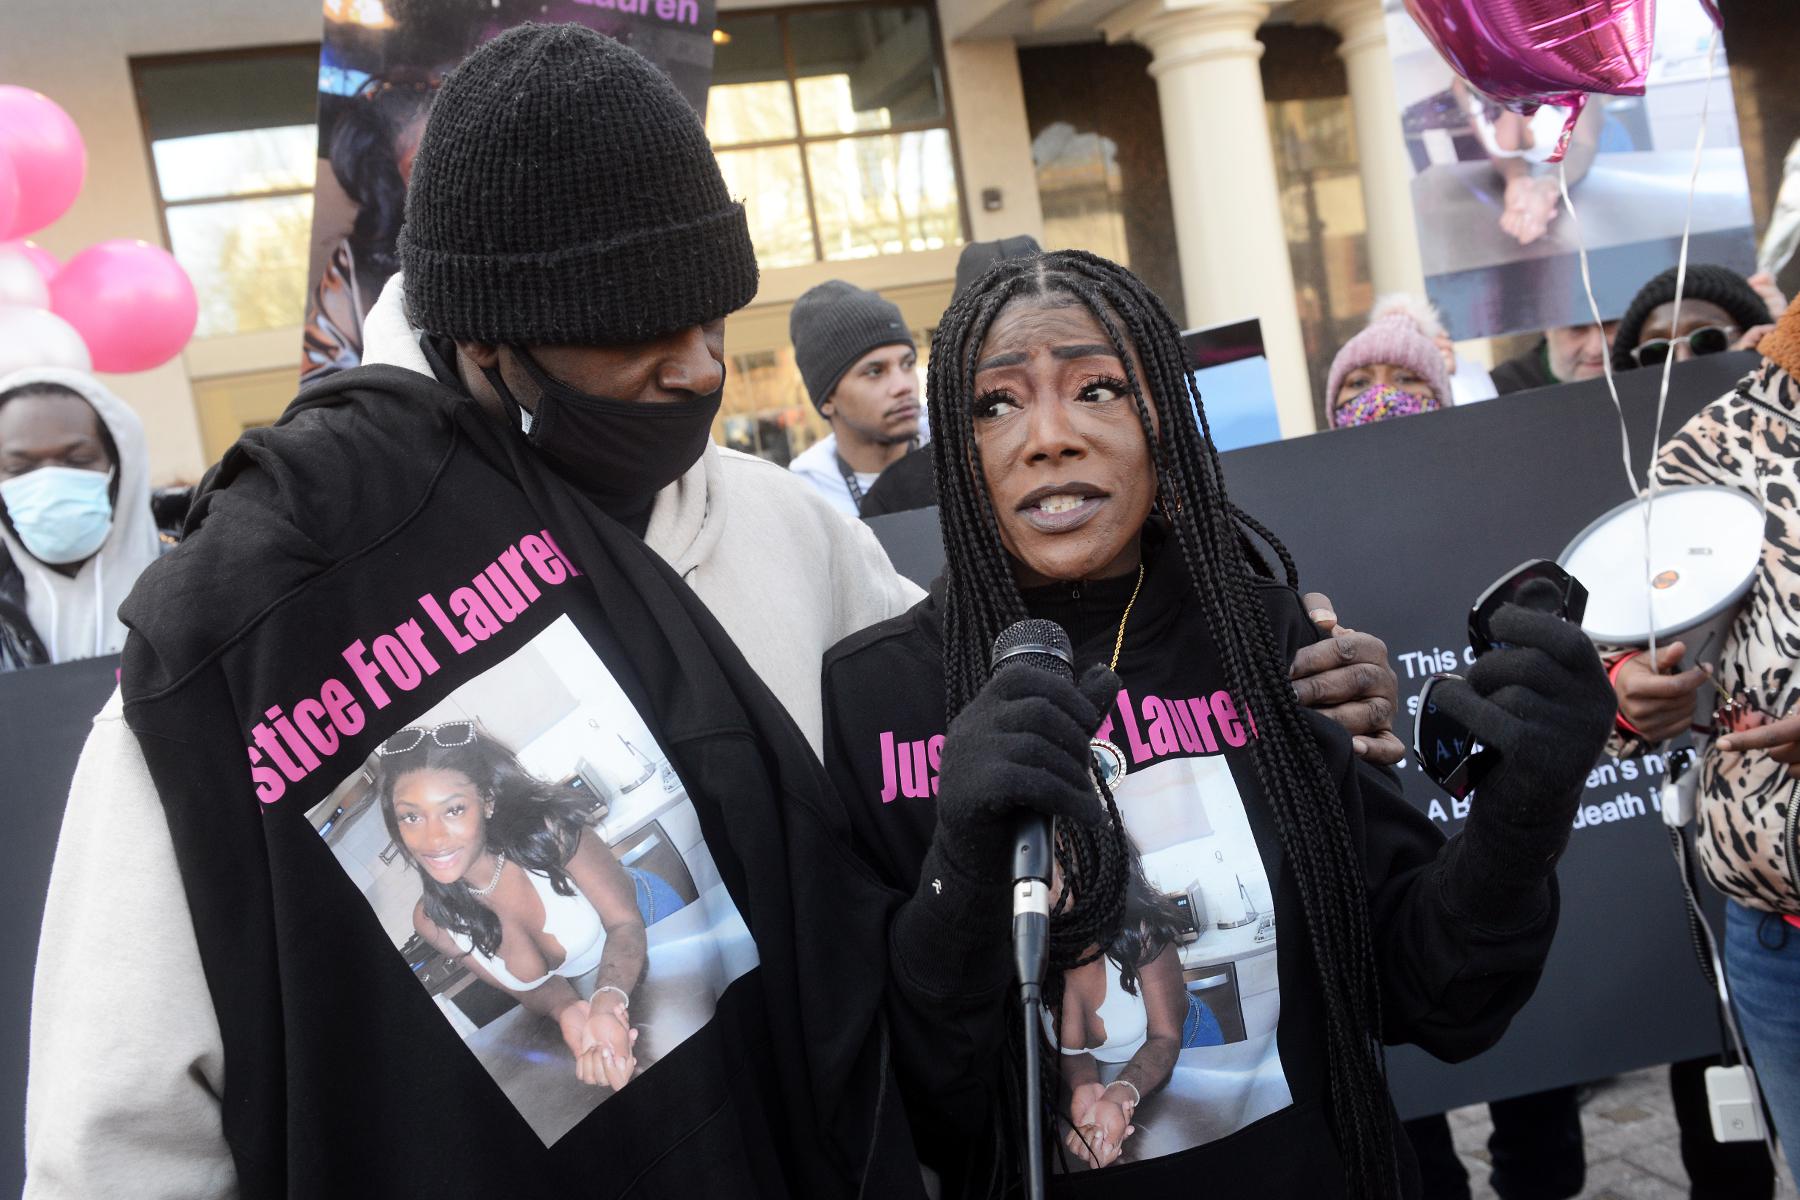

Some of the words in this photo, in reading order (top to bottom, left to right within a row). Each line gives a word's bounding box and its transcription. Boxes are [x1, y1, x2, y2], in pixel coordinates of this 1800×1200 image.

[573, 0, 699, 25] uren
[1397, 647, 1458, 679] This
[248, 678, 366, 808] stice
[341, 617, 441, 710] For
[1116, 688, 1259, 764] Laure
